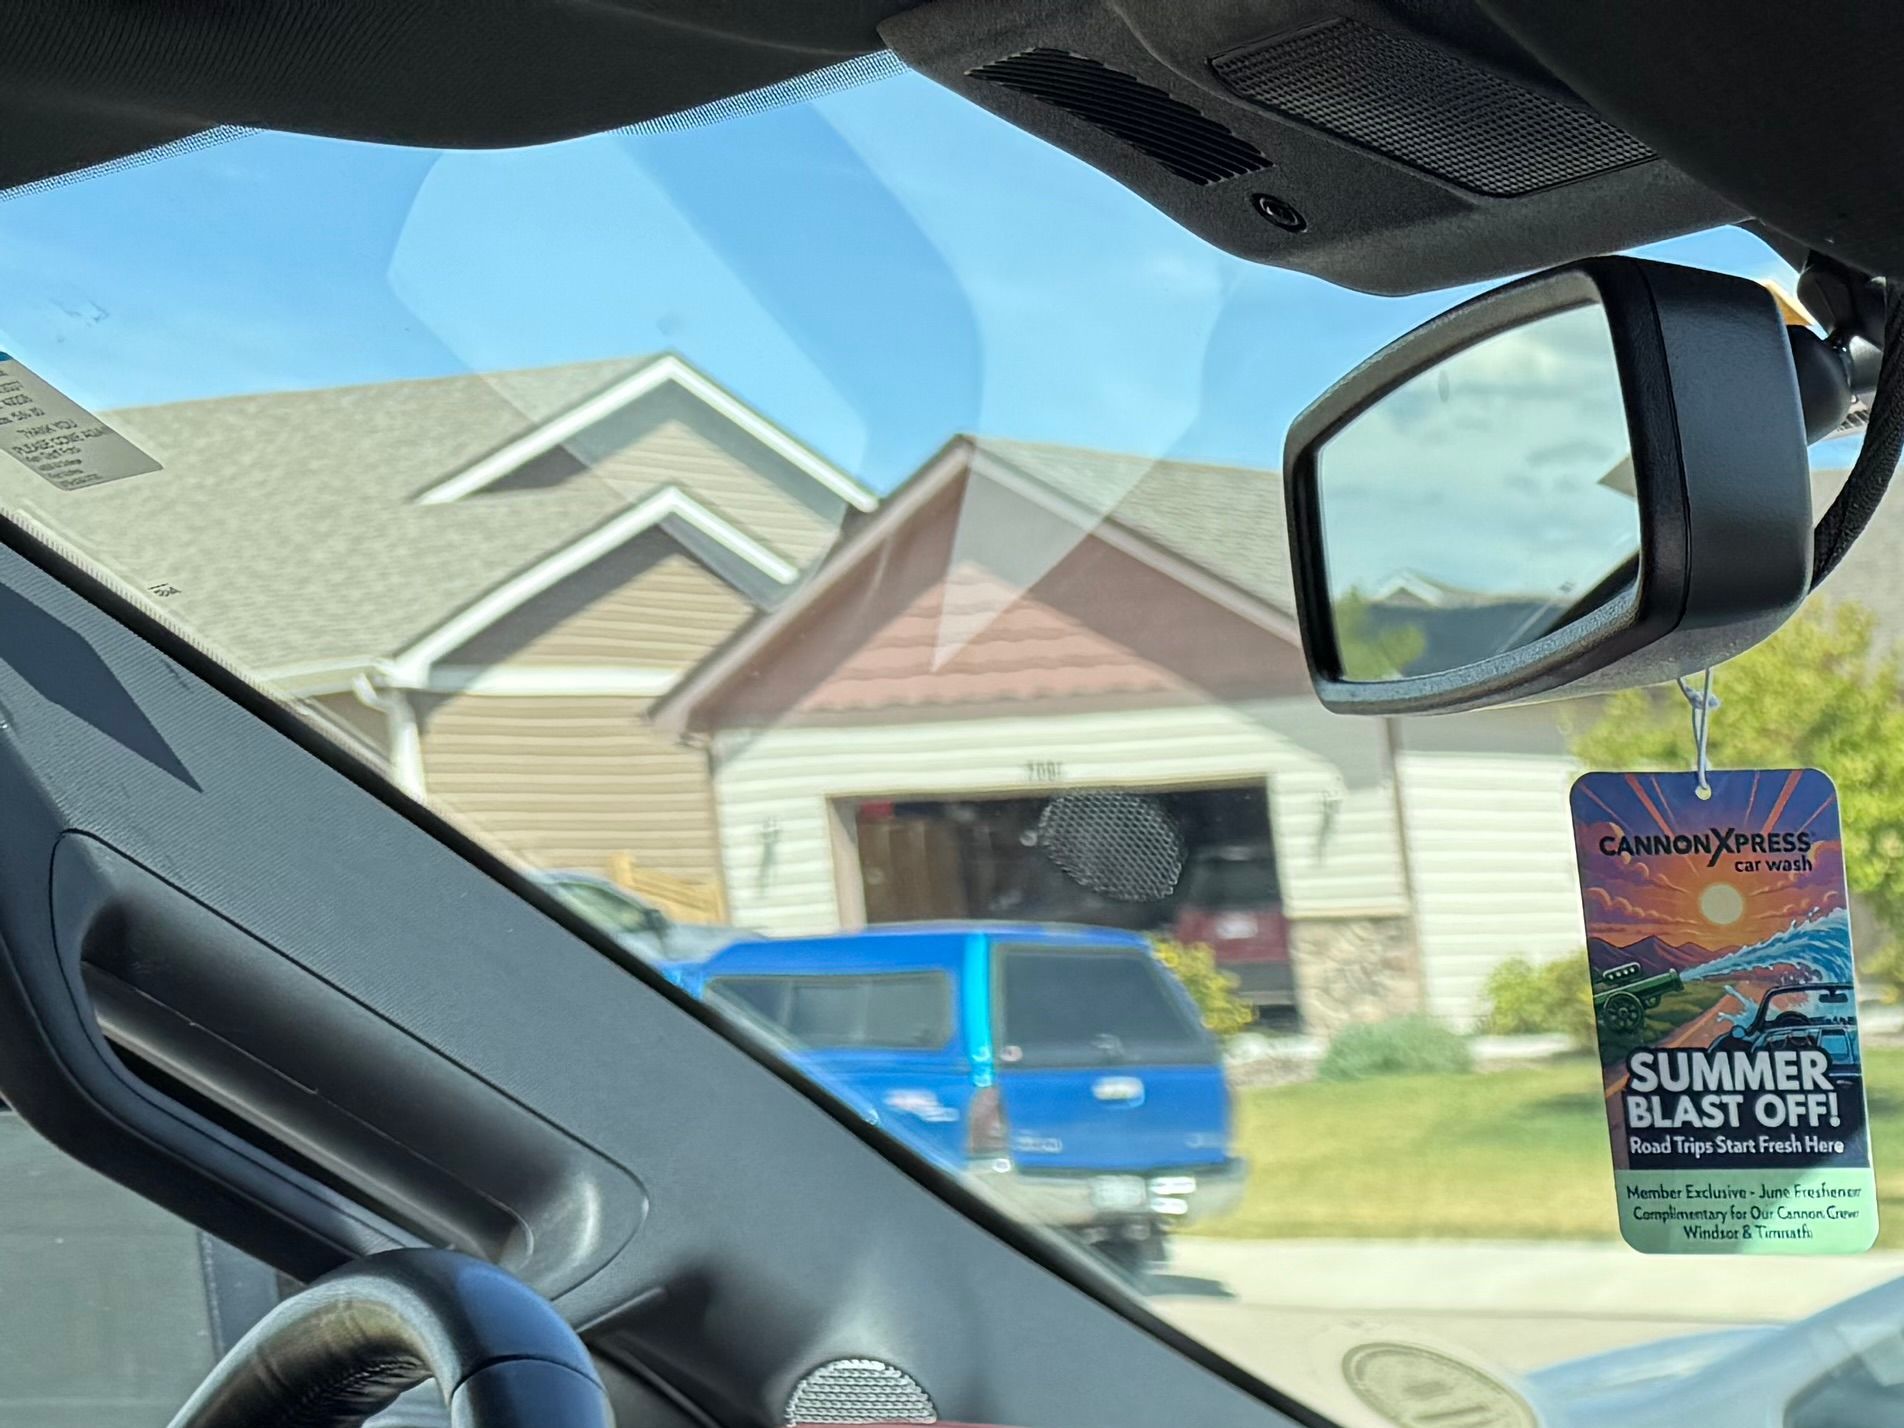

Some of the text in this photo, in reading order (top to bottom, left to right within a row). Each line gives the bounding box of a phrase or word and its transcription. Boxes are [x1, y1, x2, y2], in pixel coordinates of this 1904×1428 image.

[1600, 828, 1812, 868] CANNONXPRESS
[1735, 855, 1813, 873] car wash
[1630, 1051, 1834, 1092] SUMMER
[1627, 1092, 1840, 1128] BLAST OFF!
[1630, 1133, 1845, 1159] Road Trips Start Fresh Here
[1627, 1184, 1682, 1200] Member
[1685, 1183, 1747, 1200] Exclusive
[1758, 1183, 1790, 1200] June
[1633, 1204, 1728, 1224] Complimentary
[1730, 1204, 1747, 1220] for
[1750, 1205, 1774, 1220] Our
[1776, 1205, 1824, 1220] Cannon
[1683, 1224, 1740, 1240] Windsor
[1742, 1225, 1752, 1240] &
